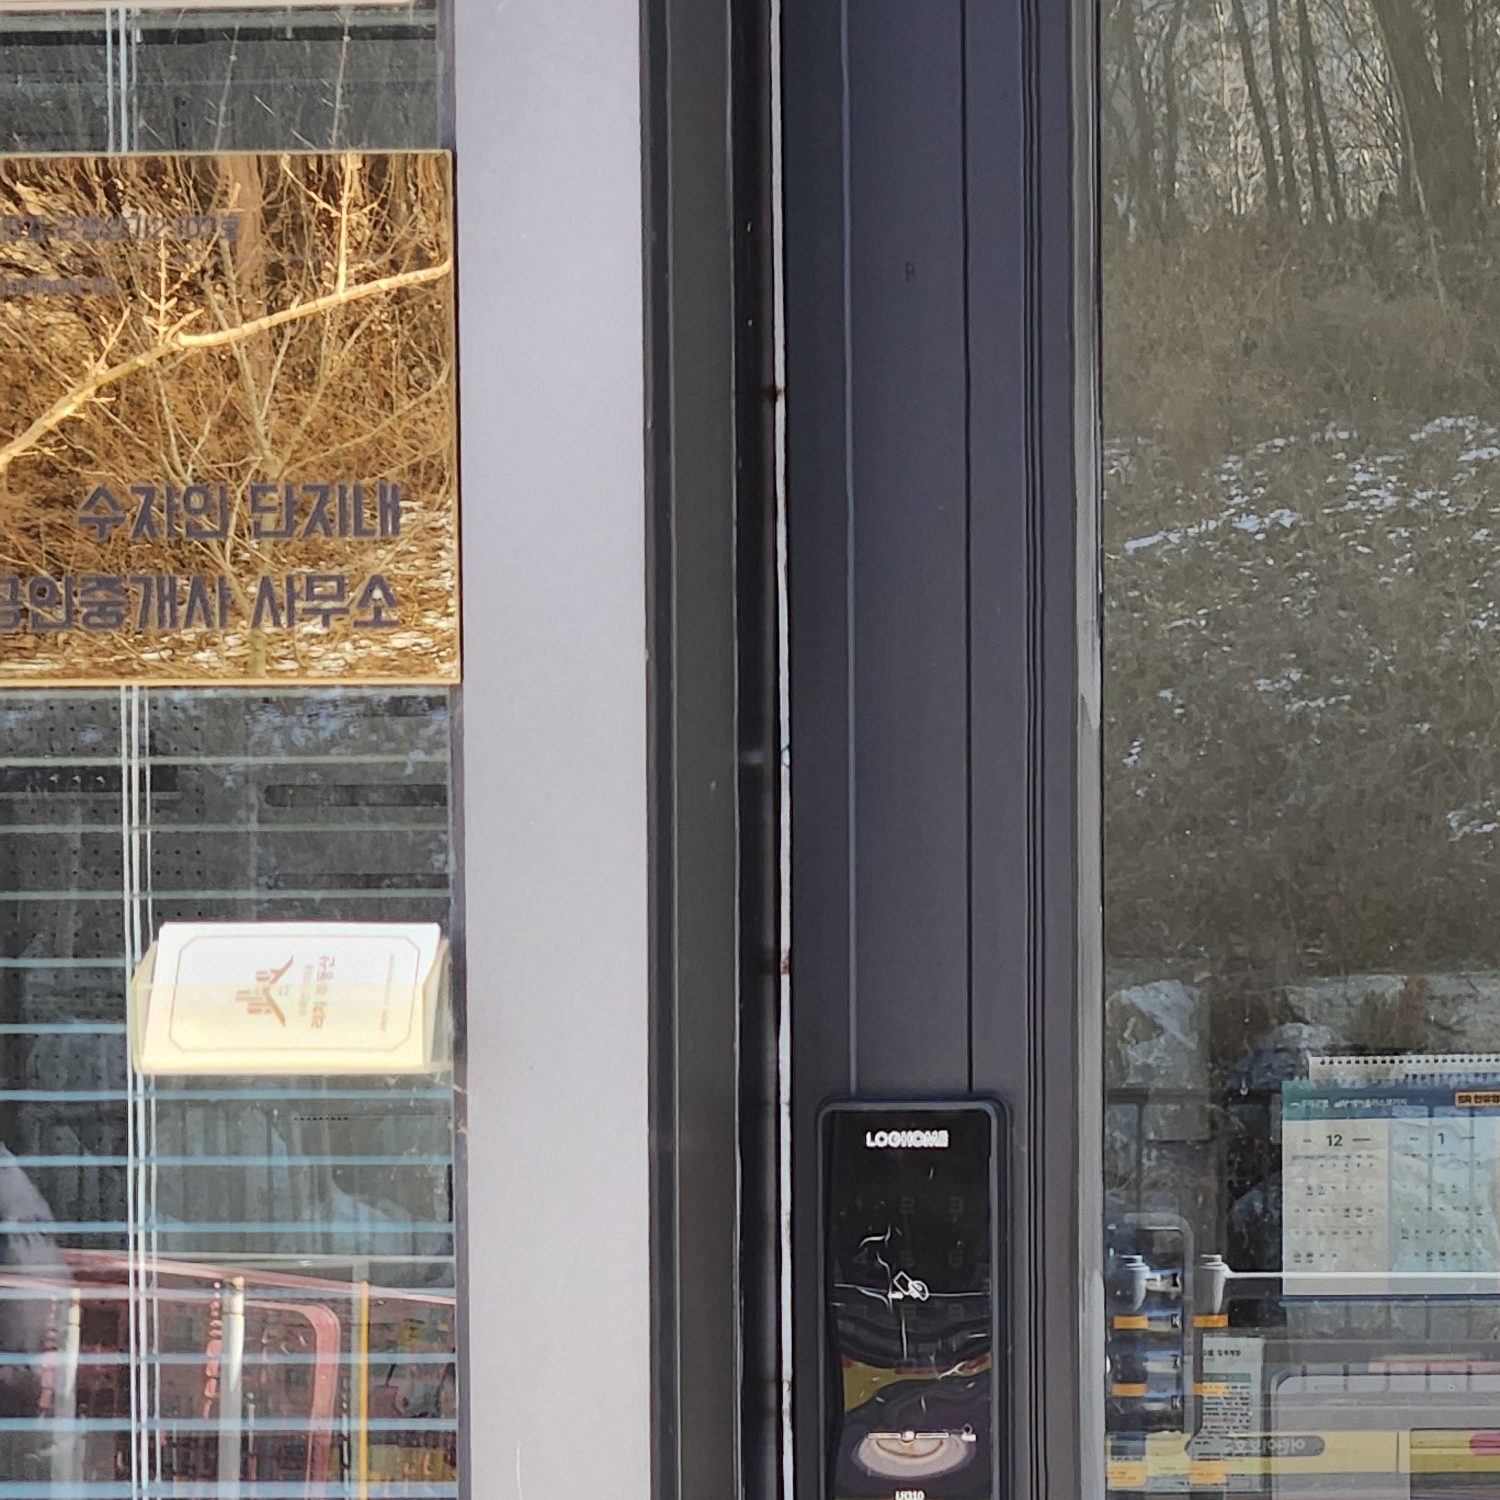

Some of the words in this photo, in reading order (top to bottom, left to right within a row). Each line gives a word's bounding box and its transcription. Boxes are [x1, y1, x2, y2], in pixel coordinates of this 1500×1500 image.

[77, 482, 230, 540] 수자인
[248, 481, 402, 540] 단지내
[250, 573, 402, 630] 사무소
[1326, 1133, 1344, 1148] 12
